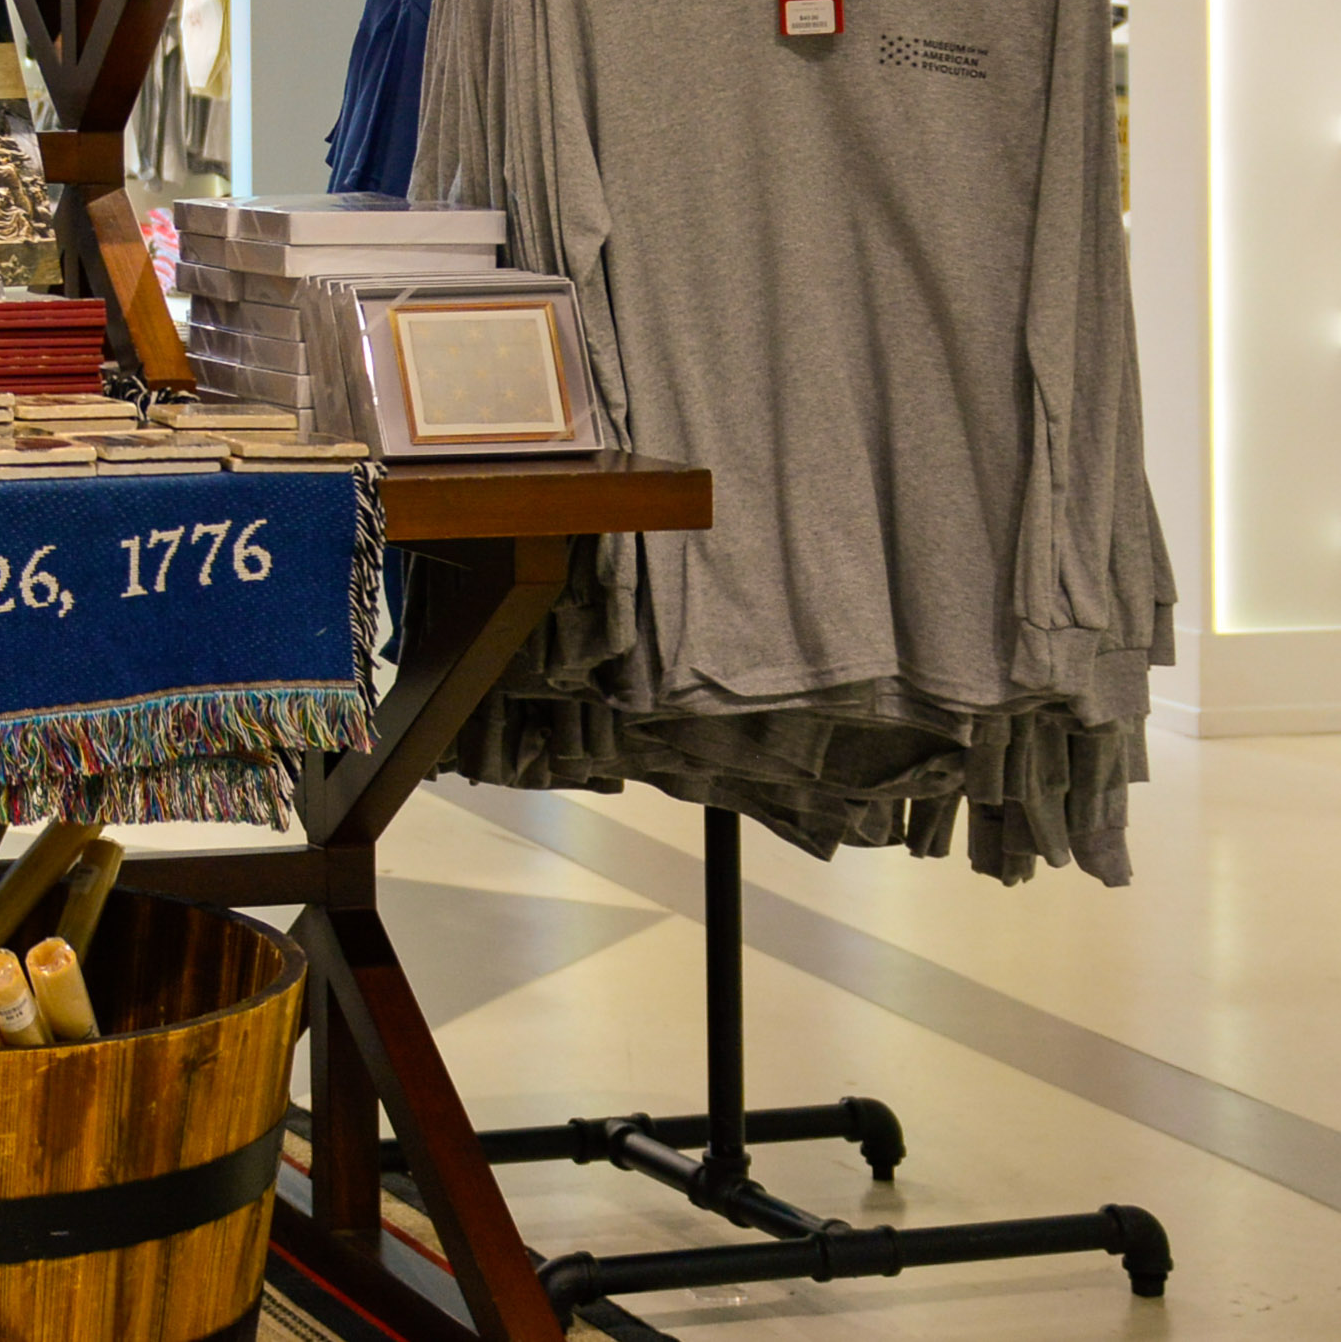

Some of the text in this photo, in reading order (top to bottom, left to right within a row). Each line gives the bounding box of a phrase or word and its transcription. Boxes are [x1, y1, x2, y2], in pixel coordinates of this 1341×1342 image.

[922, 39, 966, 54] MUSEUM
[921, 50, 979, 67] AMERICAN
[921, 61, 988, 80] REVOLUTION
[119, 517, 274, 600] 1776
